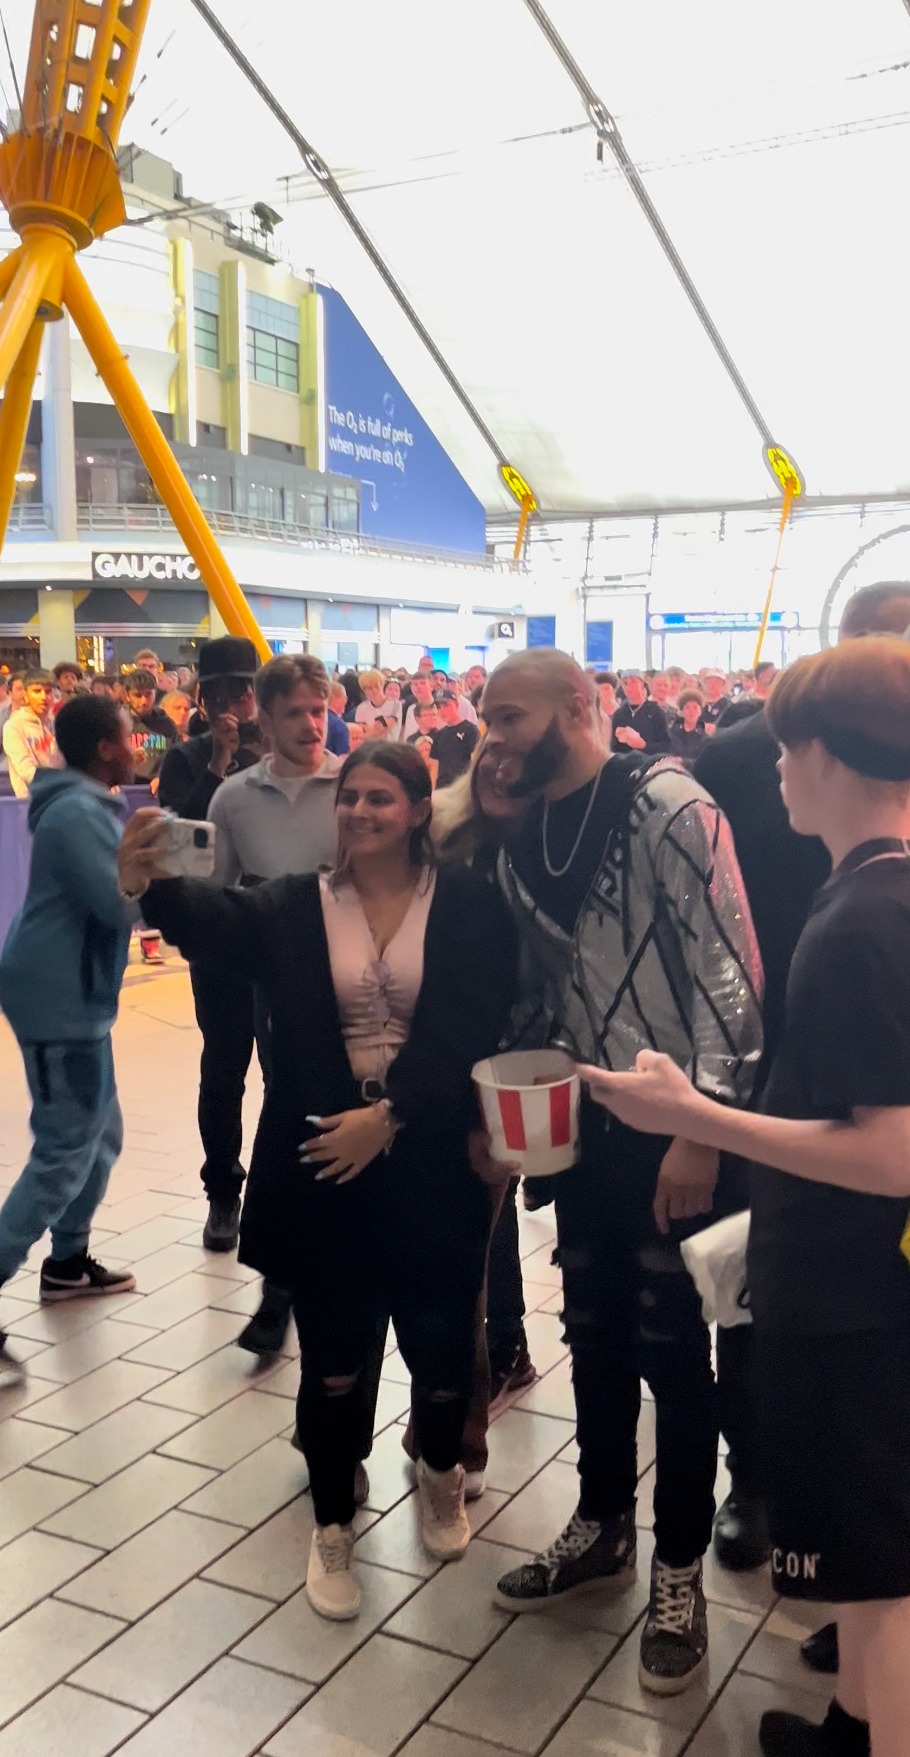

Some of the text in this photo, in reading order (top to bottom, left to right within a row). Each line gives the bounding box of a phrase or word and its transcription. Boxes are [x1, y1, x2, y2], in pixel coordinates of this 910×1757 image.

[328, 405, 345, 427] The
[358, 412, 366, 433] is
[367, 416, 381, 437] full
[382, 422, 391, 440] of
[392, 427, 414, 446] perks
[328, 433, 354, 456] when
[354, 443, 381, 462] you're
[382, 450, 393, 466] on
[94, 553, 201, 580] GAUCHO
